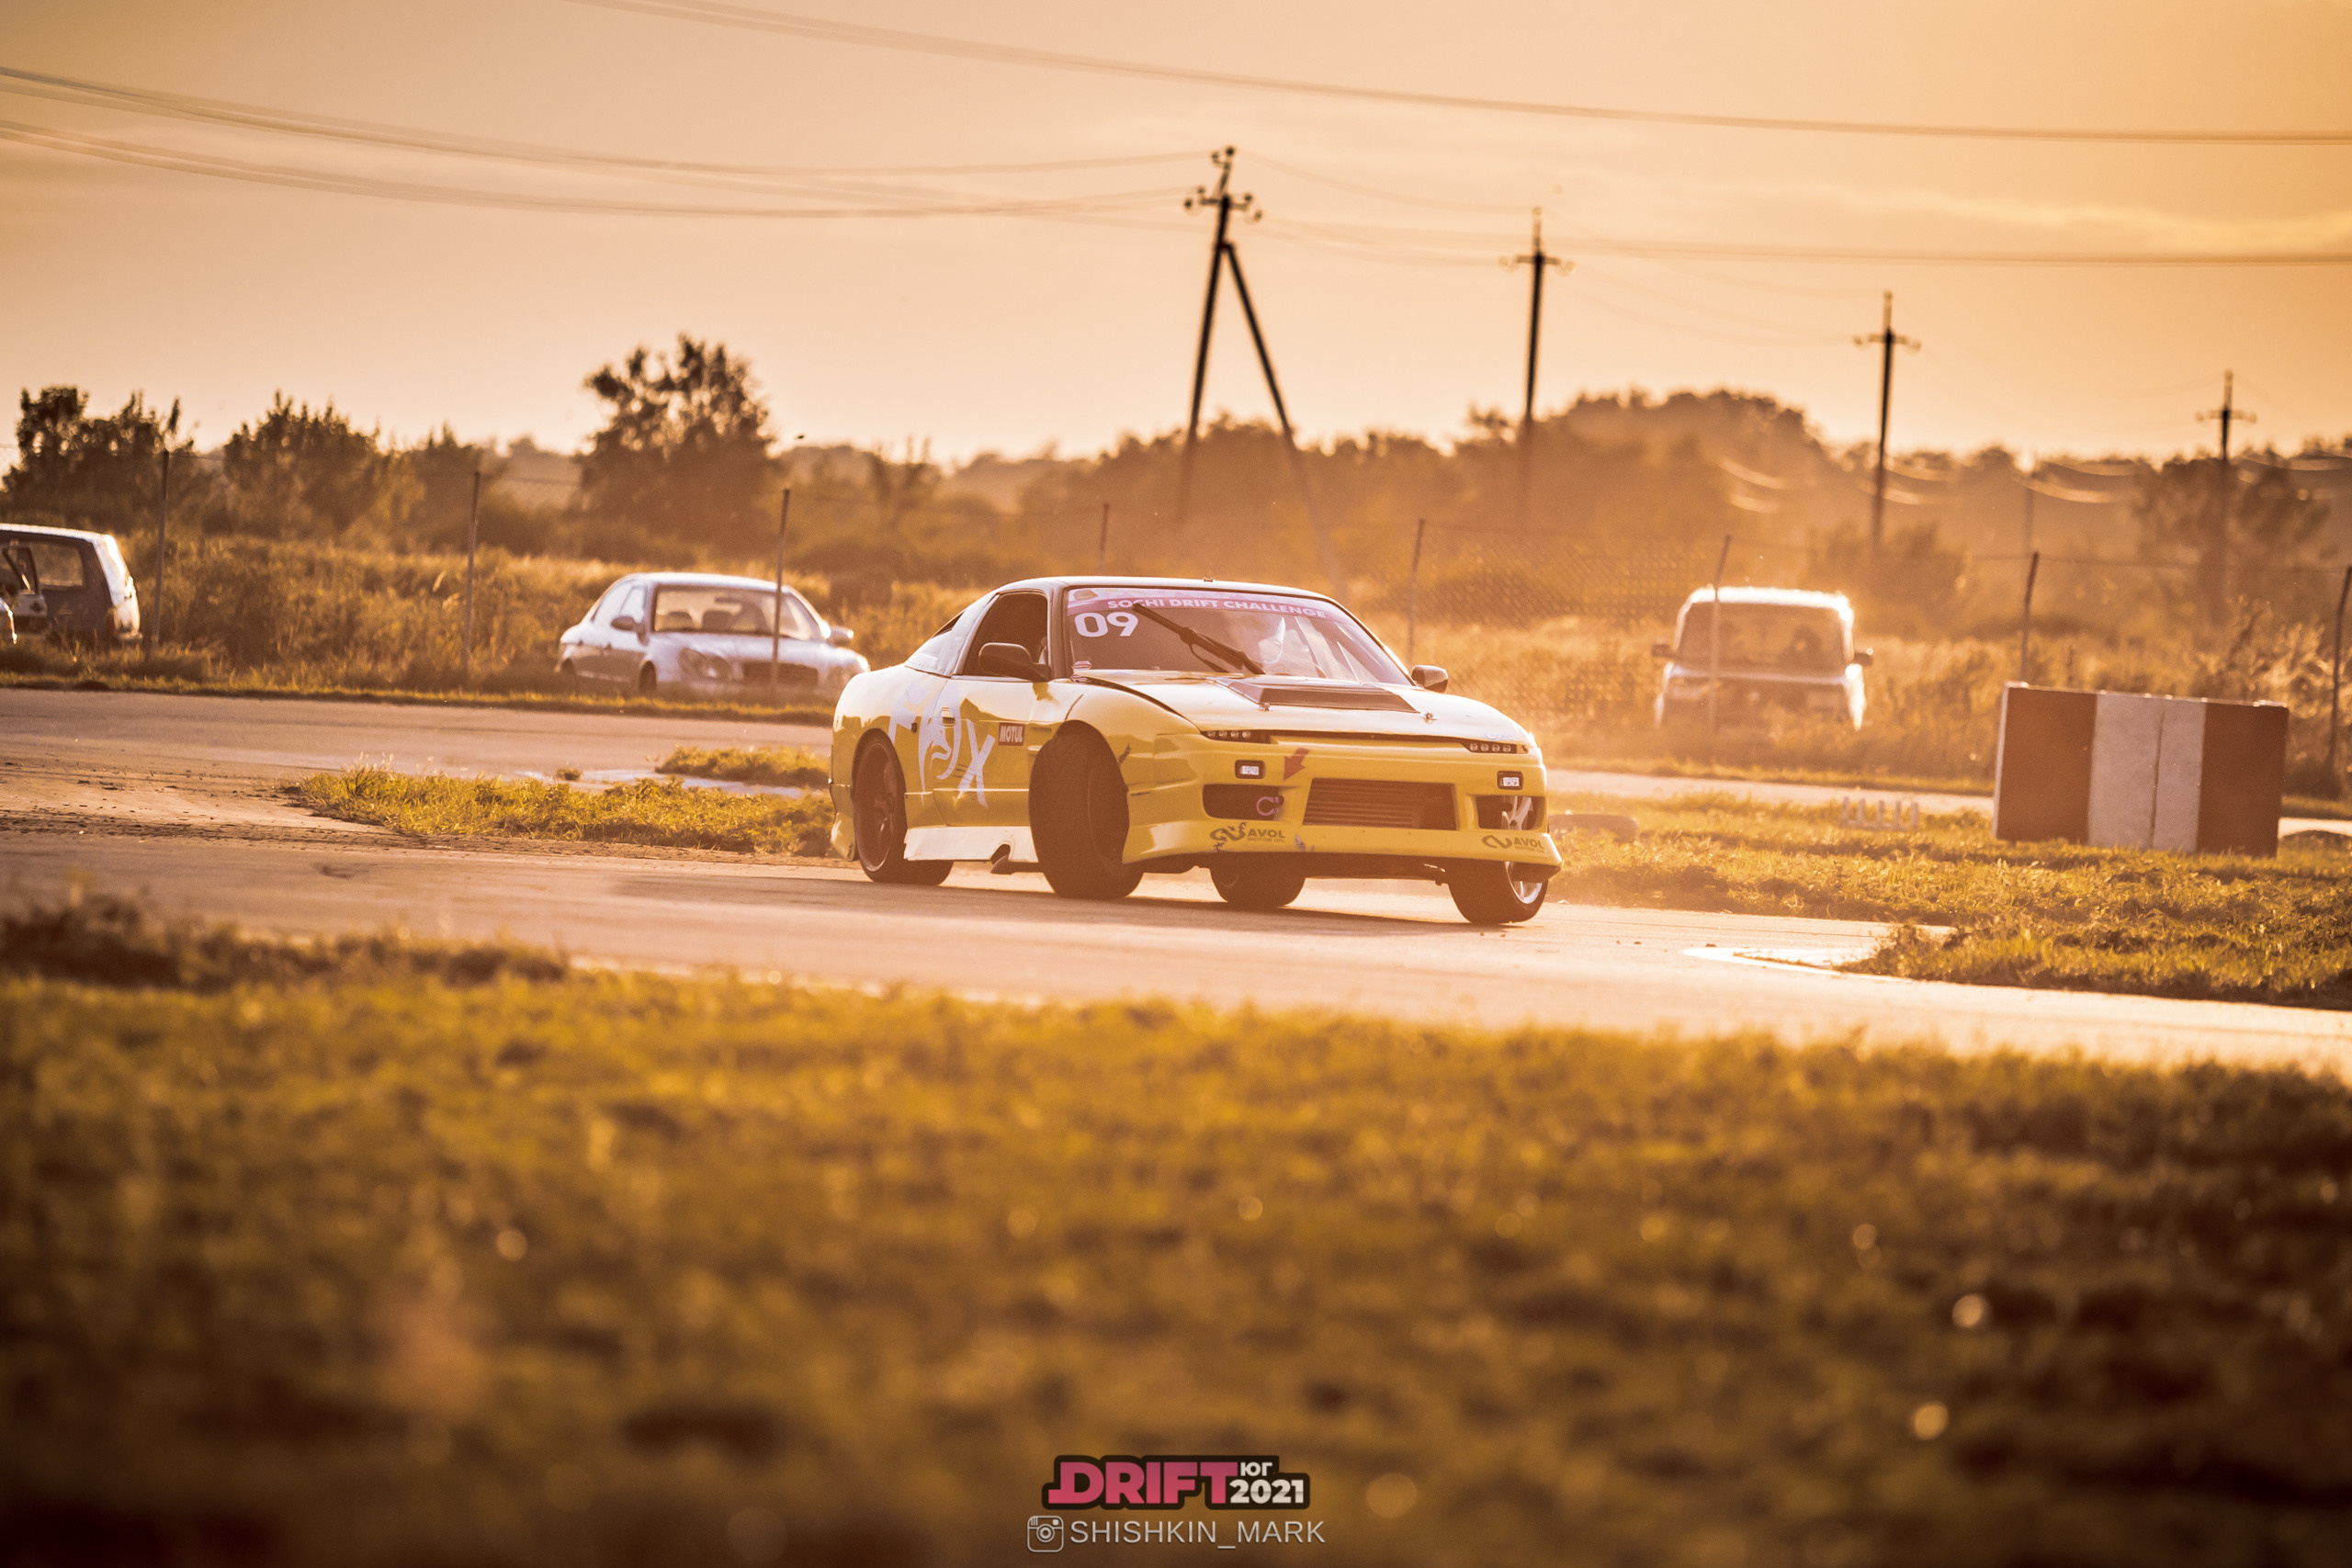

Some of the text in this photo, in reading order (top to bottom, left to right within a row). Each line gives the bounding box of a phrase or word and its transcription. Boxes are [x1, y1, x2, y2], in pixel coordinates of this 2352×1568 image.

[1107, 599, 1327, 618] SOCHI DRIFT CHALLENGE
[1073, 611, 1139, 637] 09
[998, 724, 1023, 743] MOTUL
[1248, 828, 1286, 839] AVOL
[1513, 837, 1545, 850] AVOL
